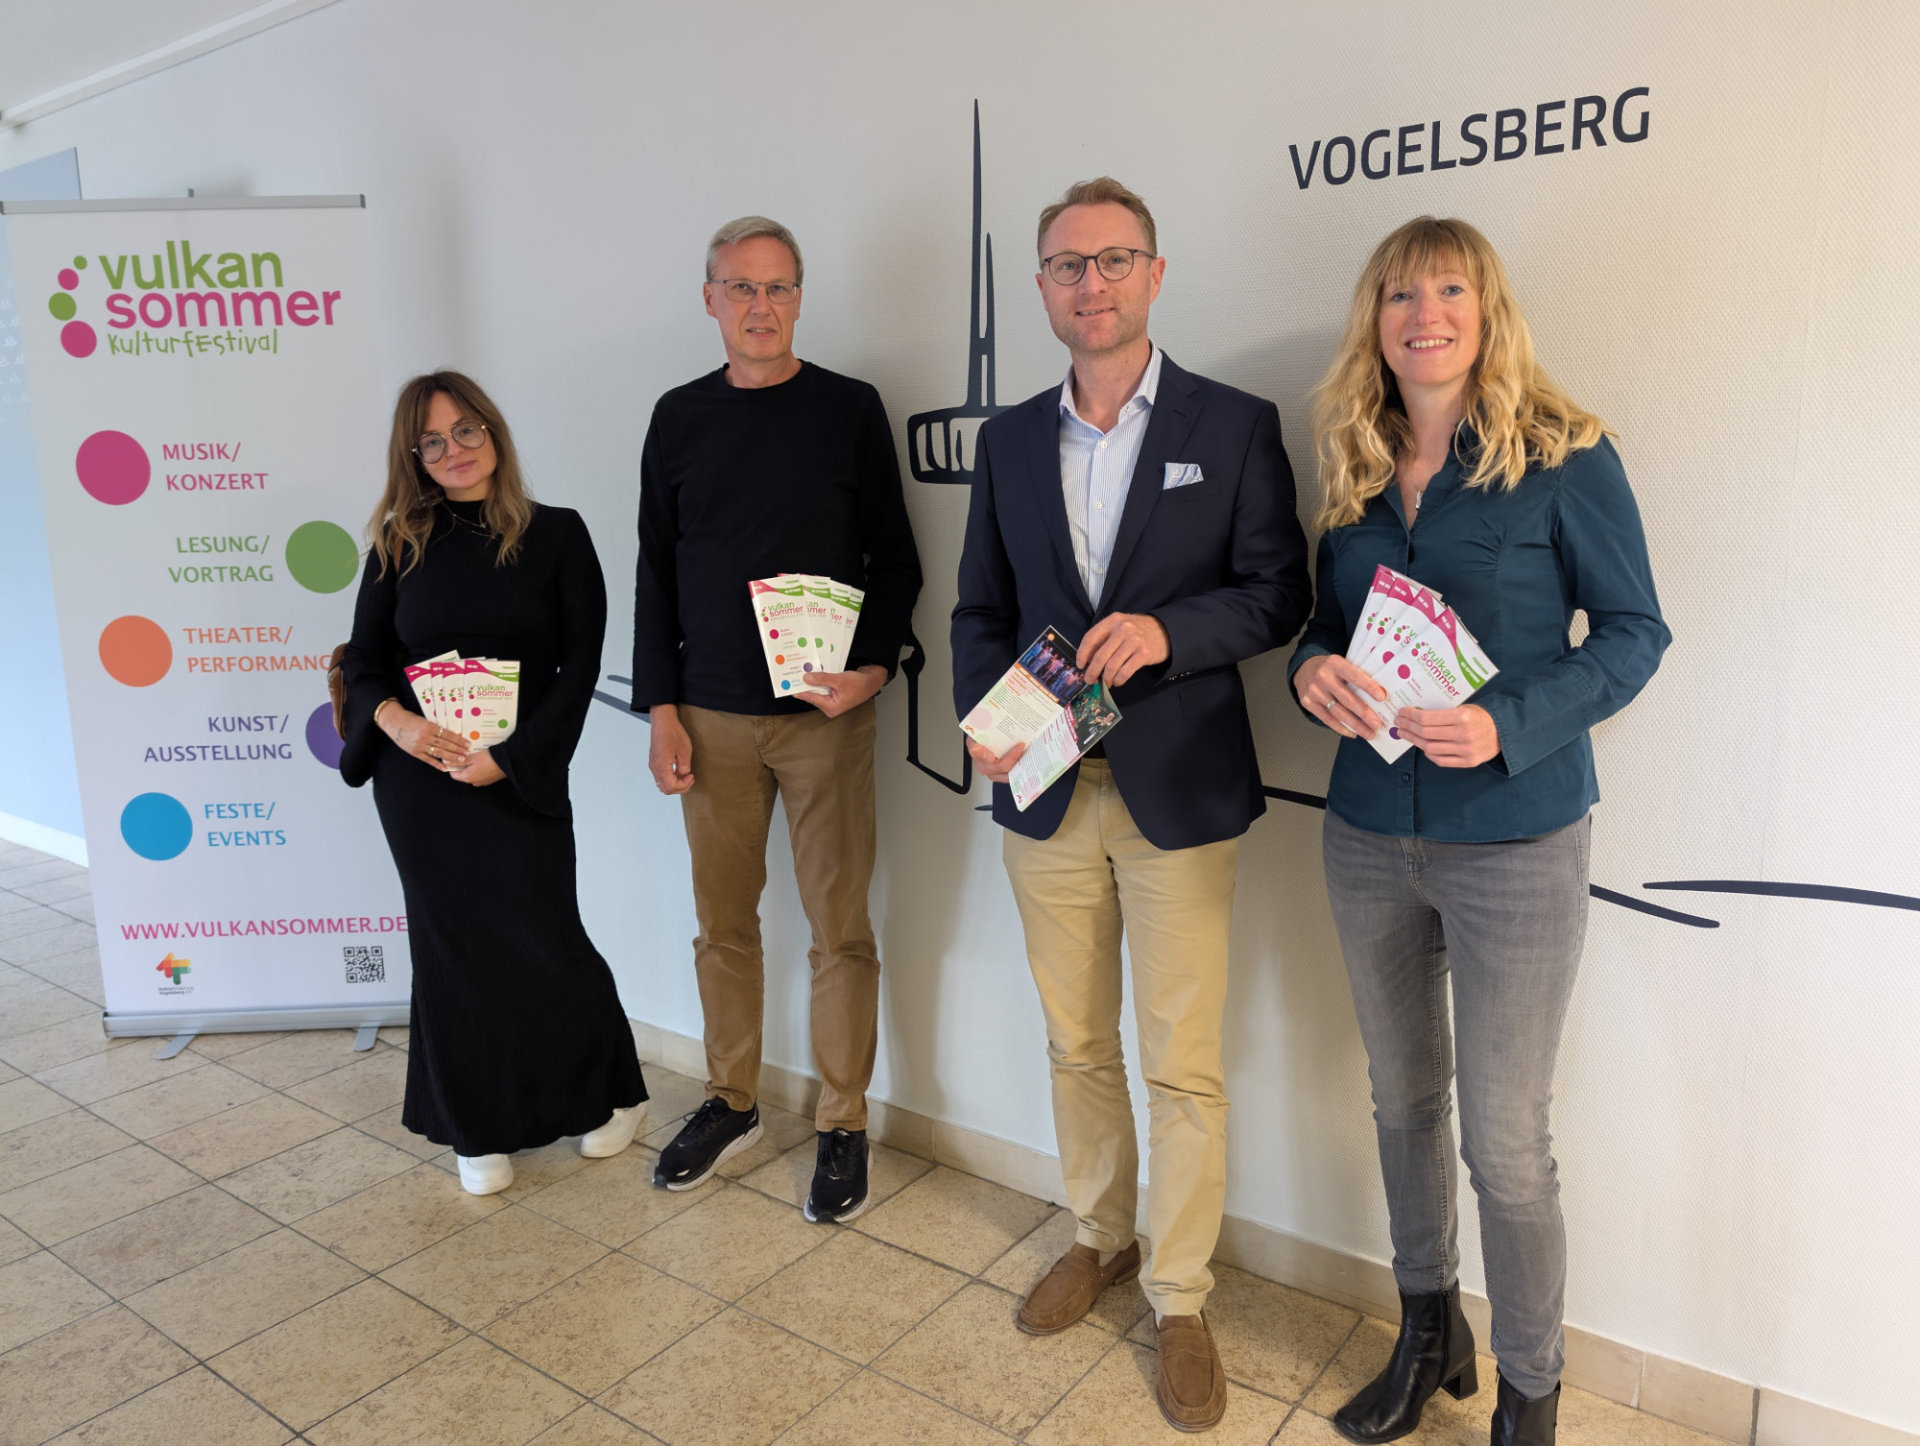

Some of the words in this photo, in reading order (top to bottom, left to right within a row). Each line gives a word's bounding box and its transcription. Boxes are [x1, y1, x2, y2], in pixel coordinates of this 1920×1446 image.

[1288, 87, 1650, 190] VOGELSBERG
[98, 240, 284, 290] vulkan
[106, 290, 342, 329] sommer
[162, 442, 241, 462] MUSIK/
[166, 473, 269, 491] KONZERT
[176, 535, 270, 554] LESUNG/
[168, 565, 274, 583] VORTRAG
[769, 606, 804, 618] sommer
[183, 626, 294, 645] THEATER/
[188, 655, 332, 673] PERFORMANC
[1427, 647, 1457, 684] vulkan
[1421, 653, 1461, 697] sommer
[207, 714, 290, 734] KUNST/
[144, 743, 293, 763] AUSSTELLUNG
[204, 802, 276, 820] FESTE/
[207, 830, 287, 847] EVENTS
[121, 916, 408, 940] WWW.VULKANSOMMER.DE
